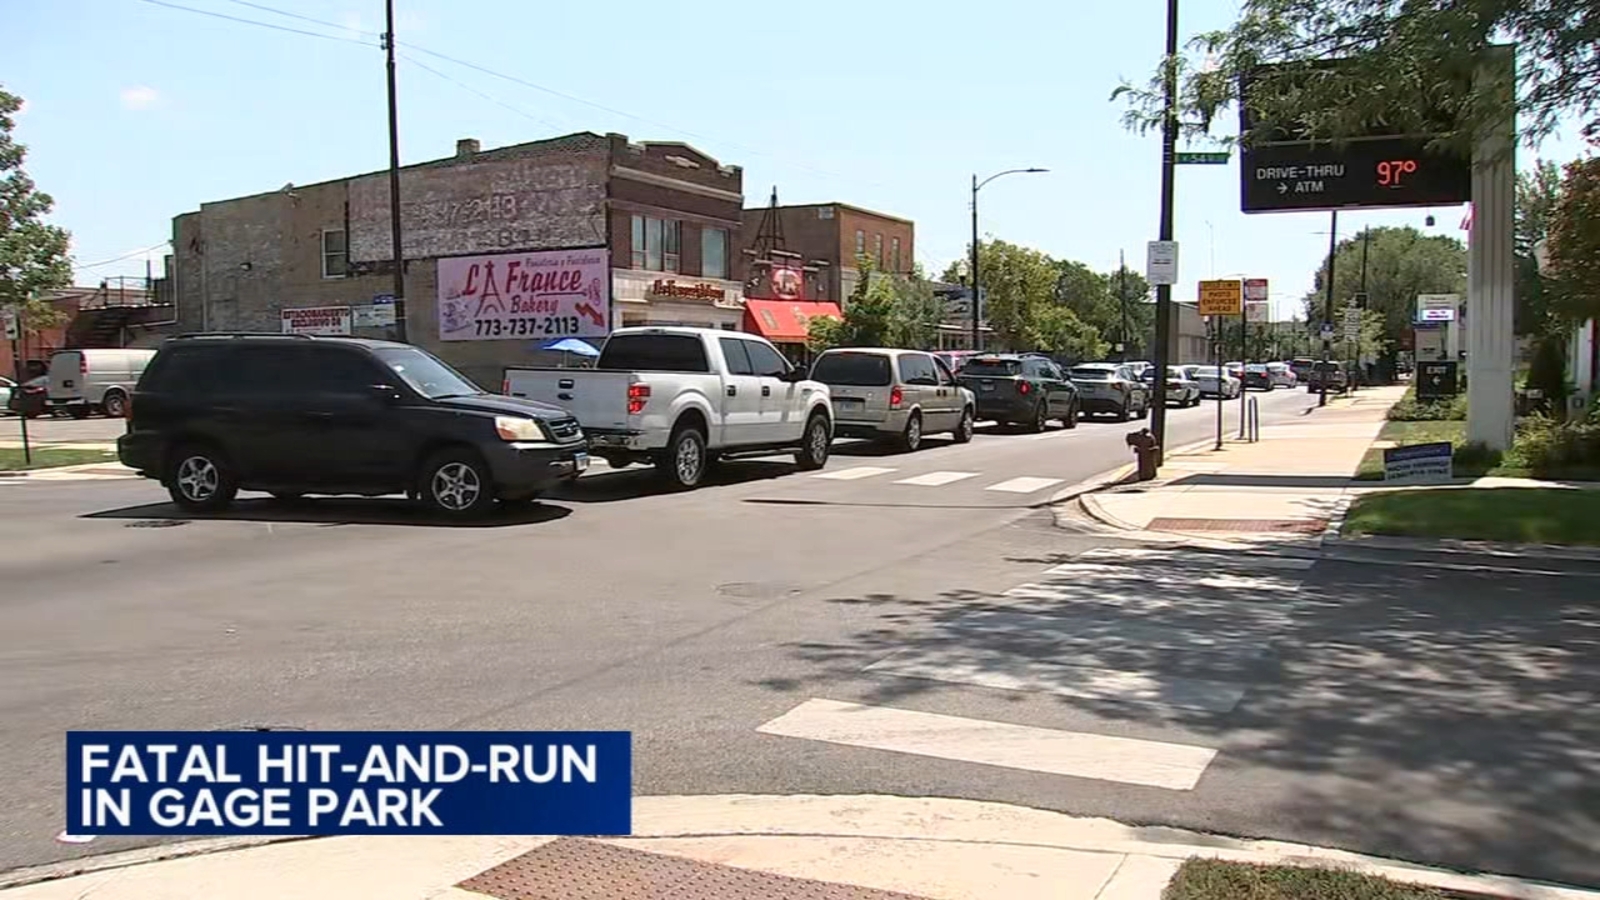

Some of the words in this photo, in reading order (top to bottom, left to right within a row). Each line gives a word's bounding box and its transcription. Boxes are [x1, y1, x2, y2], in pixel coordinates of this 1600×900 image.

[1256, 164, 1345, 180] DRIVE-THRU
[1294, 180, 1324, 193] ATM
[506, 261, 582, 293] France
[510, 295, 559, 316] Bakery
[475, 316, 580, 336] 773-737-2113
